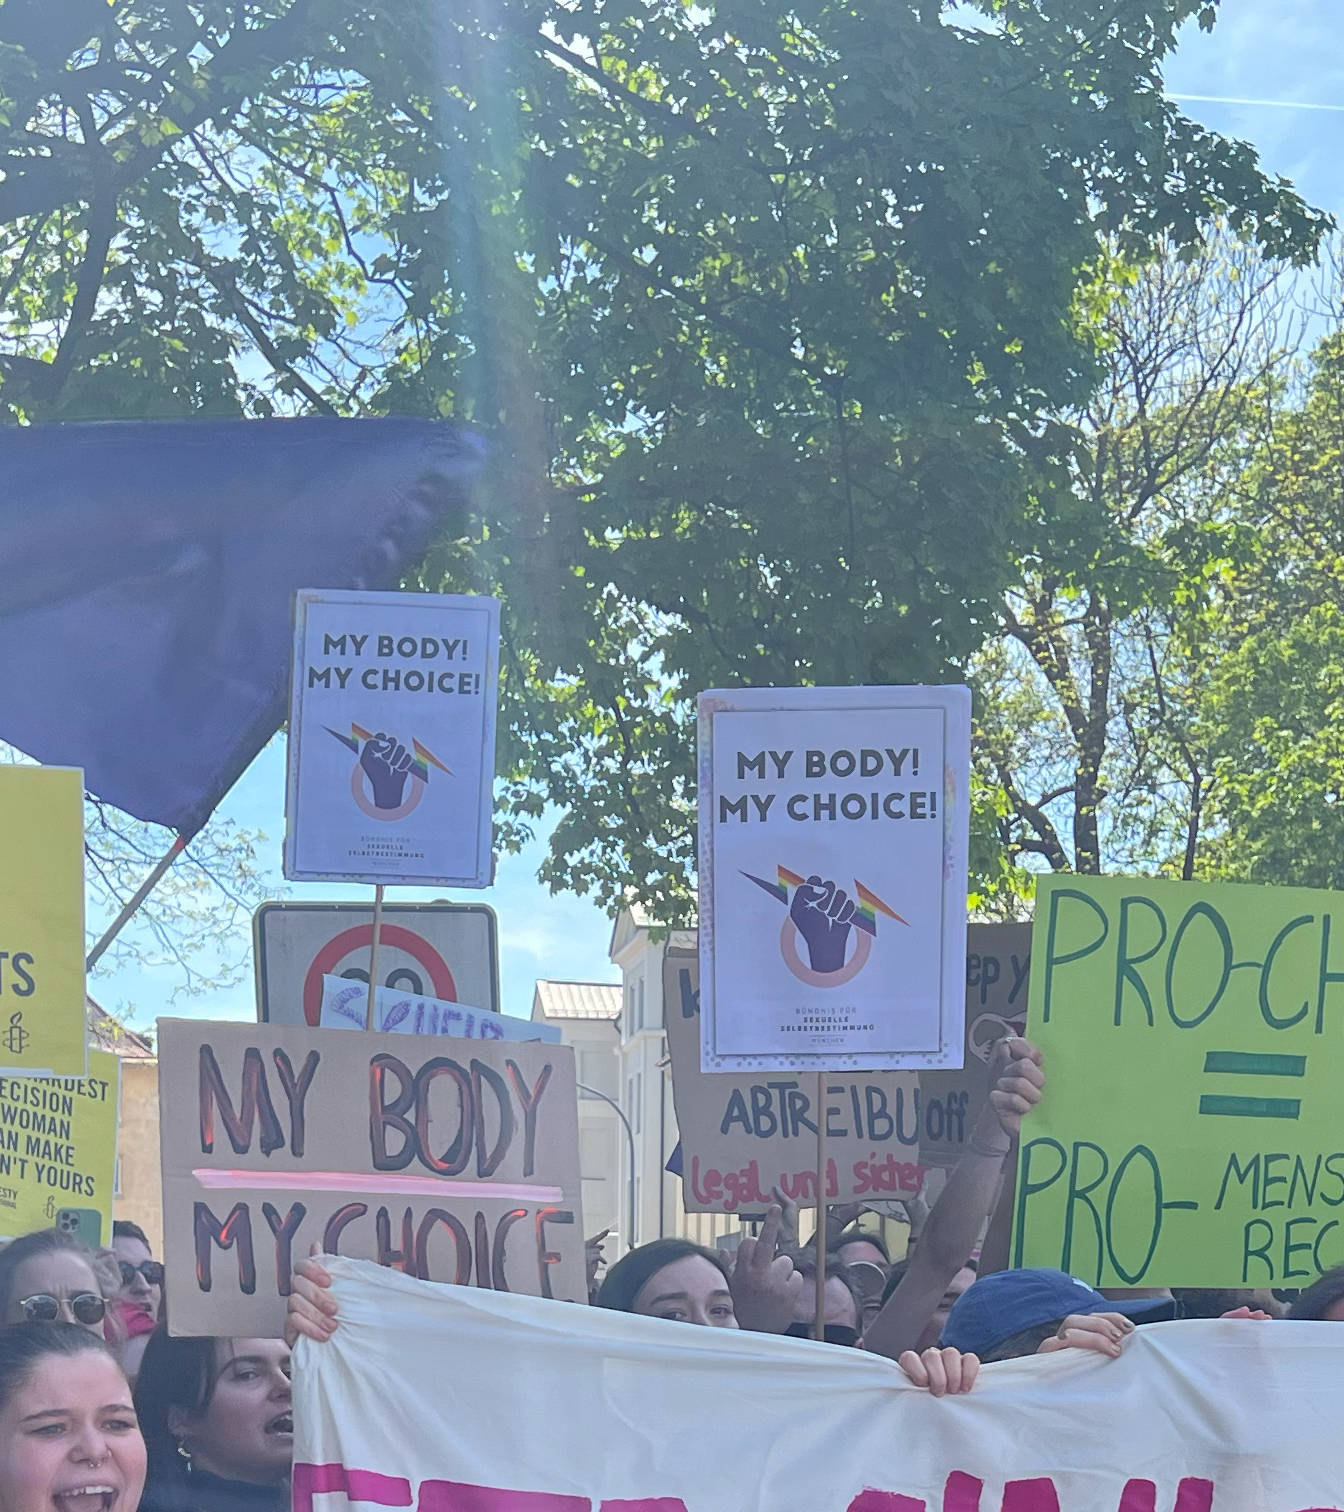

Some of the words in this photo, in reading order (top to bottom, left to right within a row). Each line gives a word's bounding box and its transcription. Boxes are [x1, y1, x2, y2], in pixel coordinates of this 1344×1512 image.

[323, 633, 369, 656] MY
[377, 635, 468, 661] BODY!
[308, 667, 353, 689] MY
[361, 669, 481, 695] CHOICE!
[737, 750, 793, 779] MY
[806, 748, 919, 778] BODY!
[719, 794, 776, 823] MY
[787, 791, 937, 821] CHOICE!
[1, 1102, 71, 1141] WOMAN
[198, 1044, 321, 1158] MY
[369, 1053, 552, 1179] BODY
[720, 1081, 921, 1146] ABTREIBU
[25, 1134, 75, 1167] MAKE
[34, 1162, 95, 1197] YOURS
[780, 1157, 839, 1200] und
[1012, 1136, 1199, 1287] PRO-
[194, 1202, 307, 1297] MY
[323, 1203, 575, 1304] CHOICE
